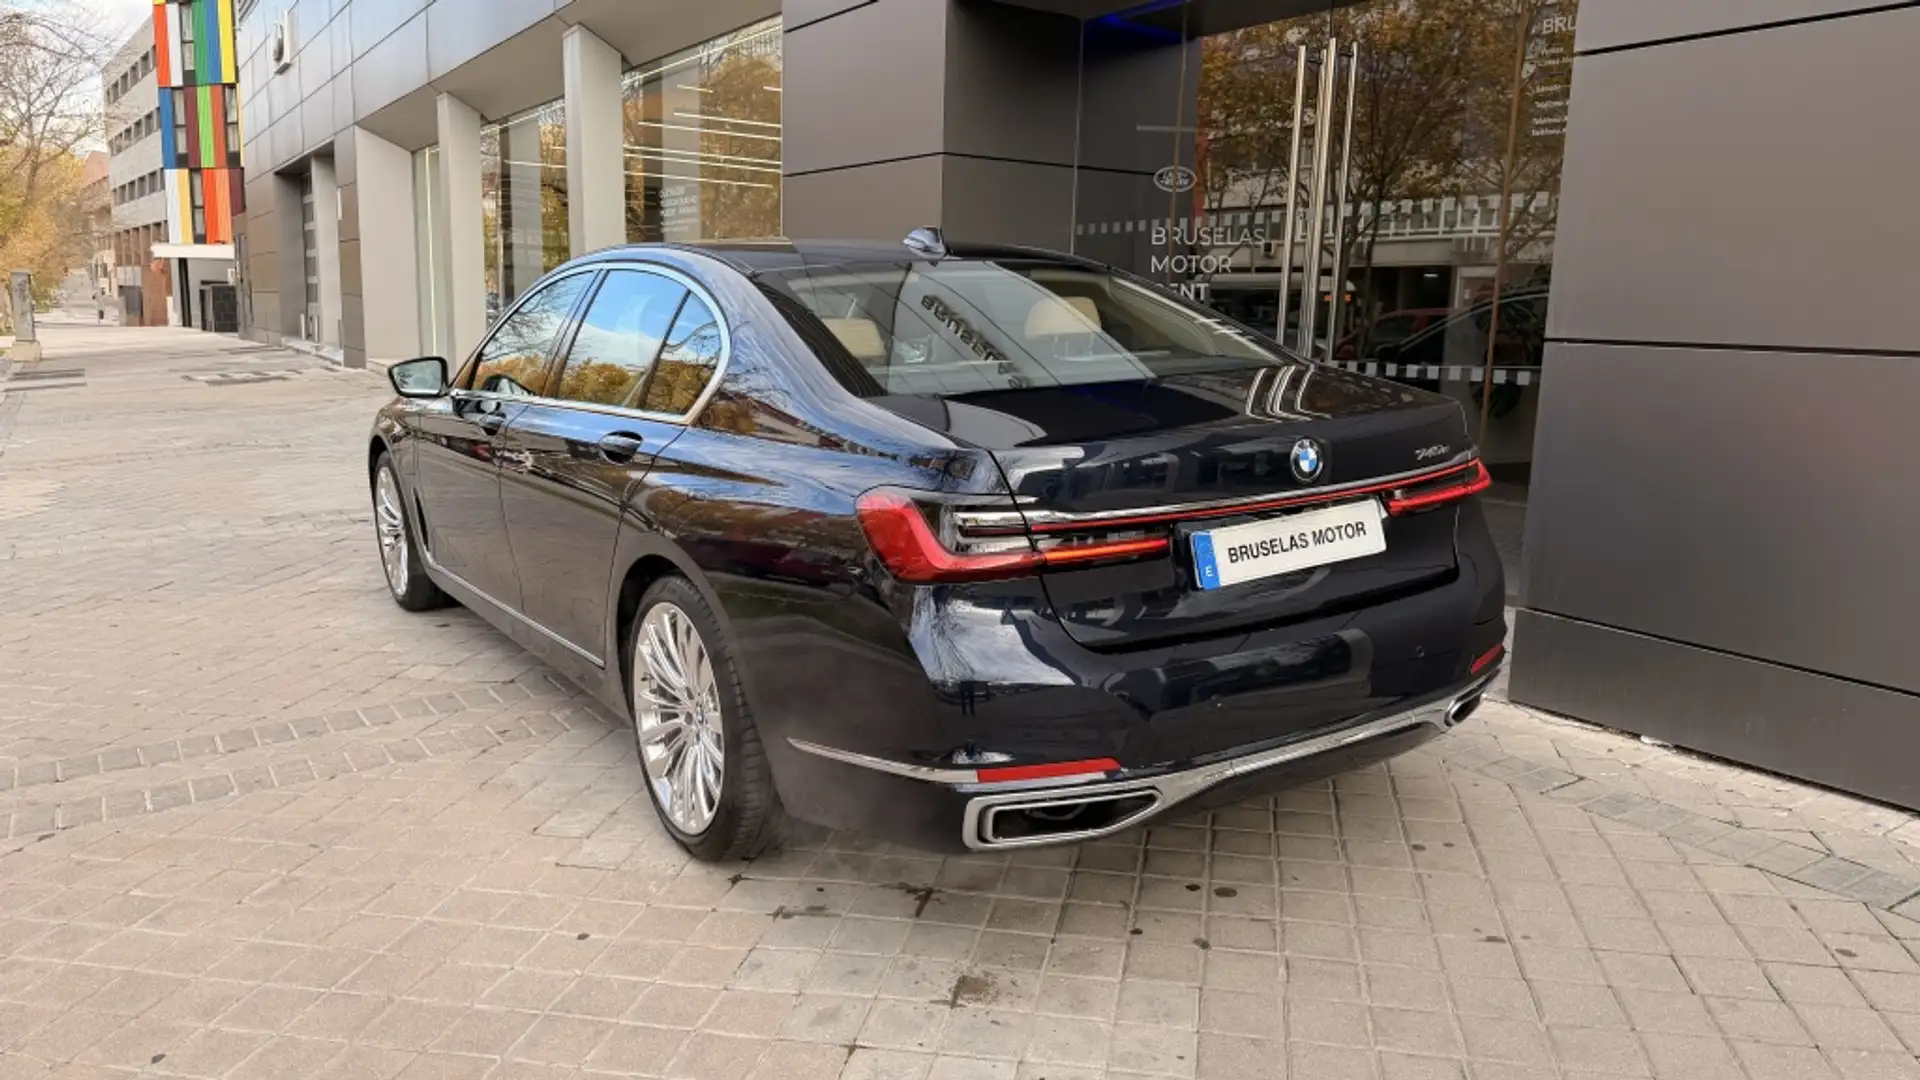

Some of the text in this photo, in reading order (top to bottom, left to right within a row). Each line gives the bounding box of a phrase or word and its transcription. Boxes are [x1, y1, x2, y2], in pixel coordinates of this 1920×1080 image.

[1151, 226, 1265, 246] BRUSELAS
[1151, 255, 1232, 273] MOTOR
[1155, 282, 1209, 301] NT
[1227, 520, 1367, 565] BRUSELAS MOTOR
[1205, 565, 1214, 577] E
